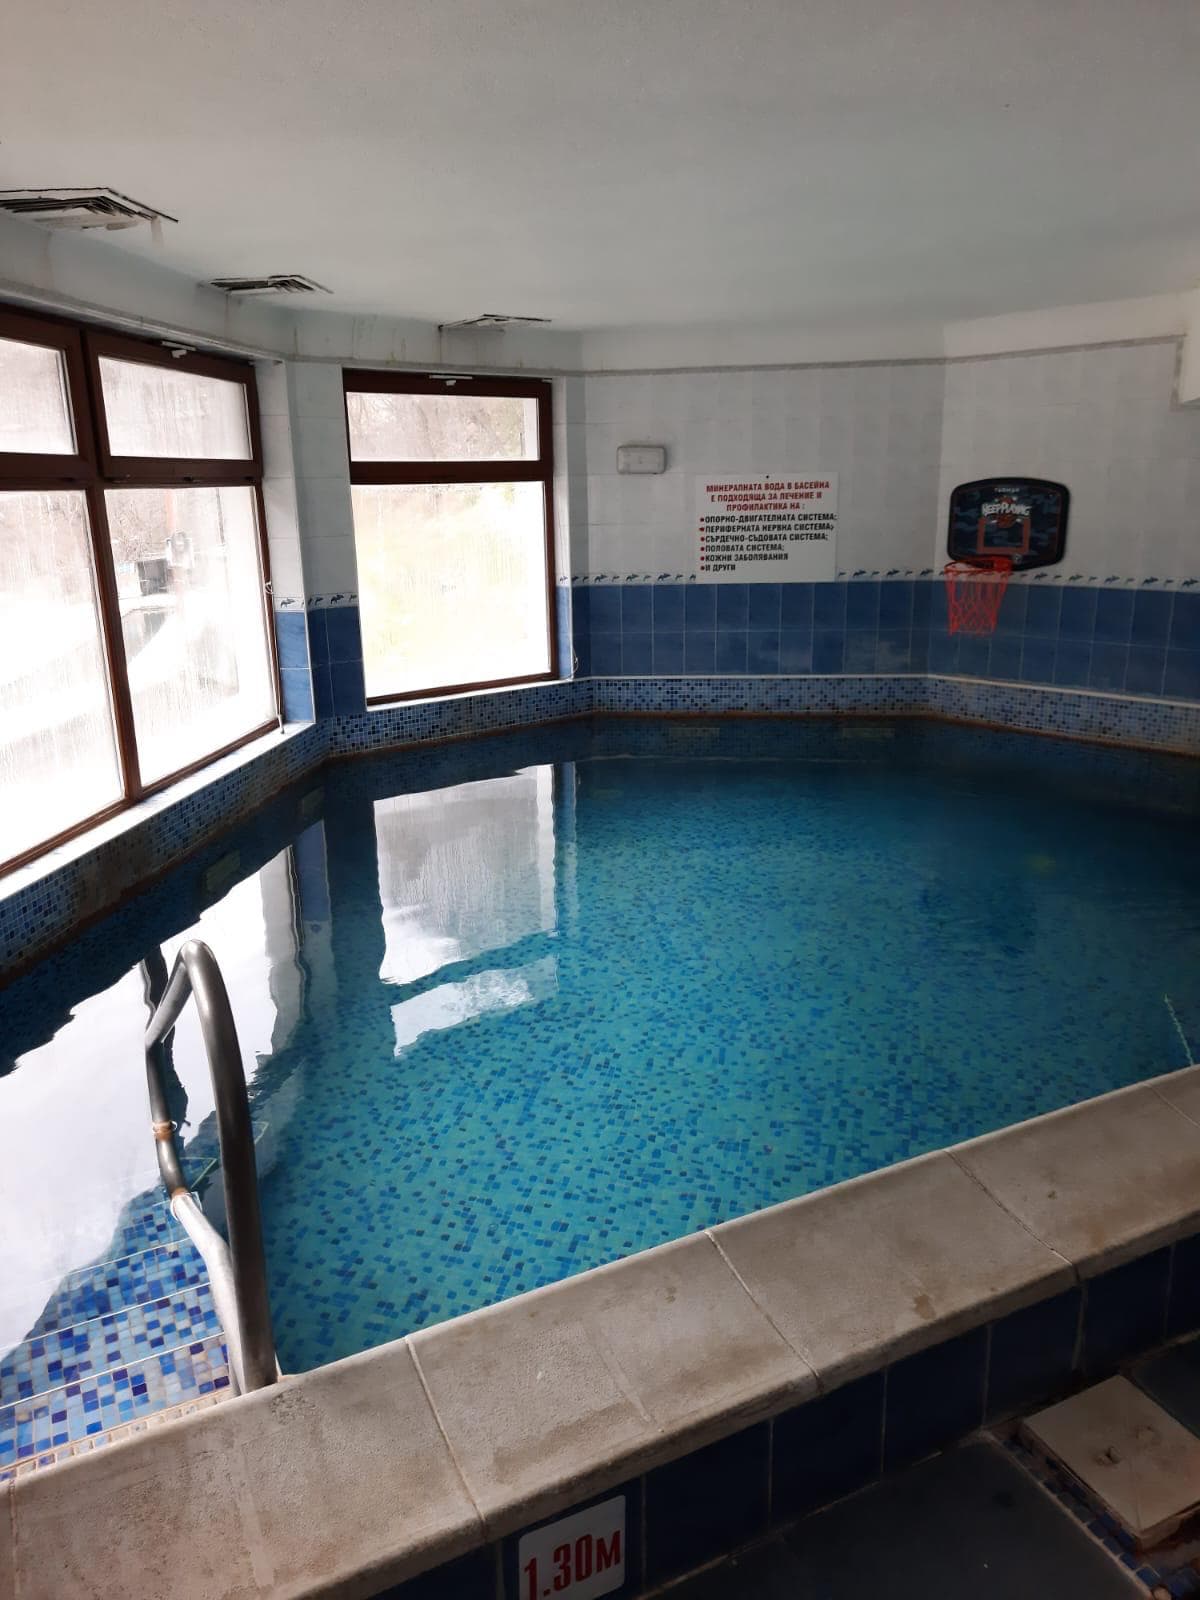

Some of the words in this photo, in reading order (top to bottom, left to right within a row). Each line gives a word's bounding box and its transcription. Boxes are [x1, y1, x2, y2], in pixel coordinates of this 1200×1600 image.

[706, 482, 762, 492] МИНЕРАЛНАТА
[765, 482, 785, 490] ВОДА
[787, 482, 792, 490] В
[794, 480, 830, 490] БАСЕЙНА
[717, 493, 766, 503] ПОДХОДЯЩА
[768, 493, 778, 501] ЗА
[780, 491, 814, 500] ЛЕЧЕНИЕ
[816, 491, 822, 499] И
[726, 502, 788, 512] ПРОФИЛАКТИКА
[790, 501, 801, 510] НА
[705, 514, 796, 524] ОПОРНО-ДВИГАТЕЛНАТА
[705, 525, 760, 533] ПЕРИФЕРНАТА
[762, 524, 792, 532] НЕРВНА
[705, 533, 788, 543] СЪРДЕЧНО-СЪДОВАТА
[705, 544, 744, 552] ПОЛОВАТА
[734, 553, 789, 561] ЗАБОЛЯВАНИЯ
[712, 564, 736, 572] ДРУГИ
